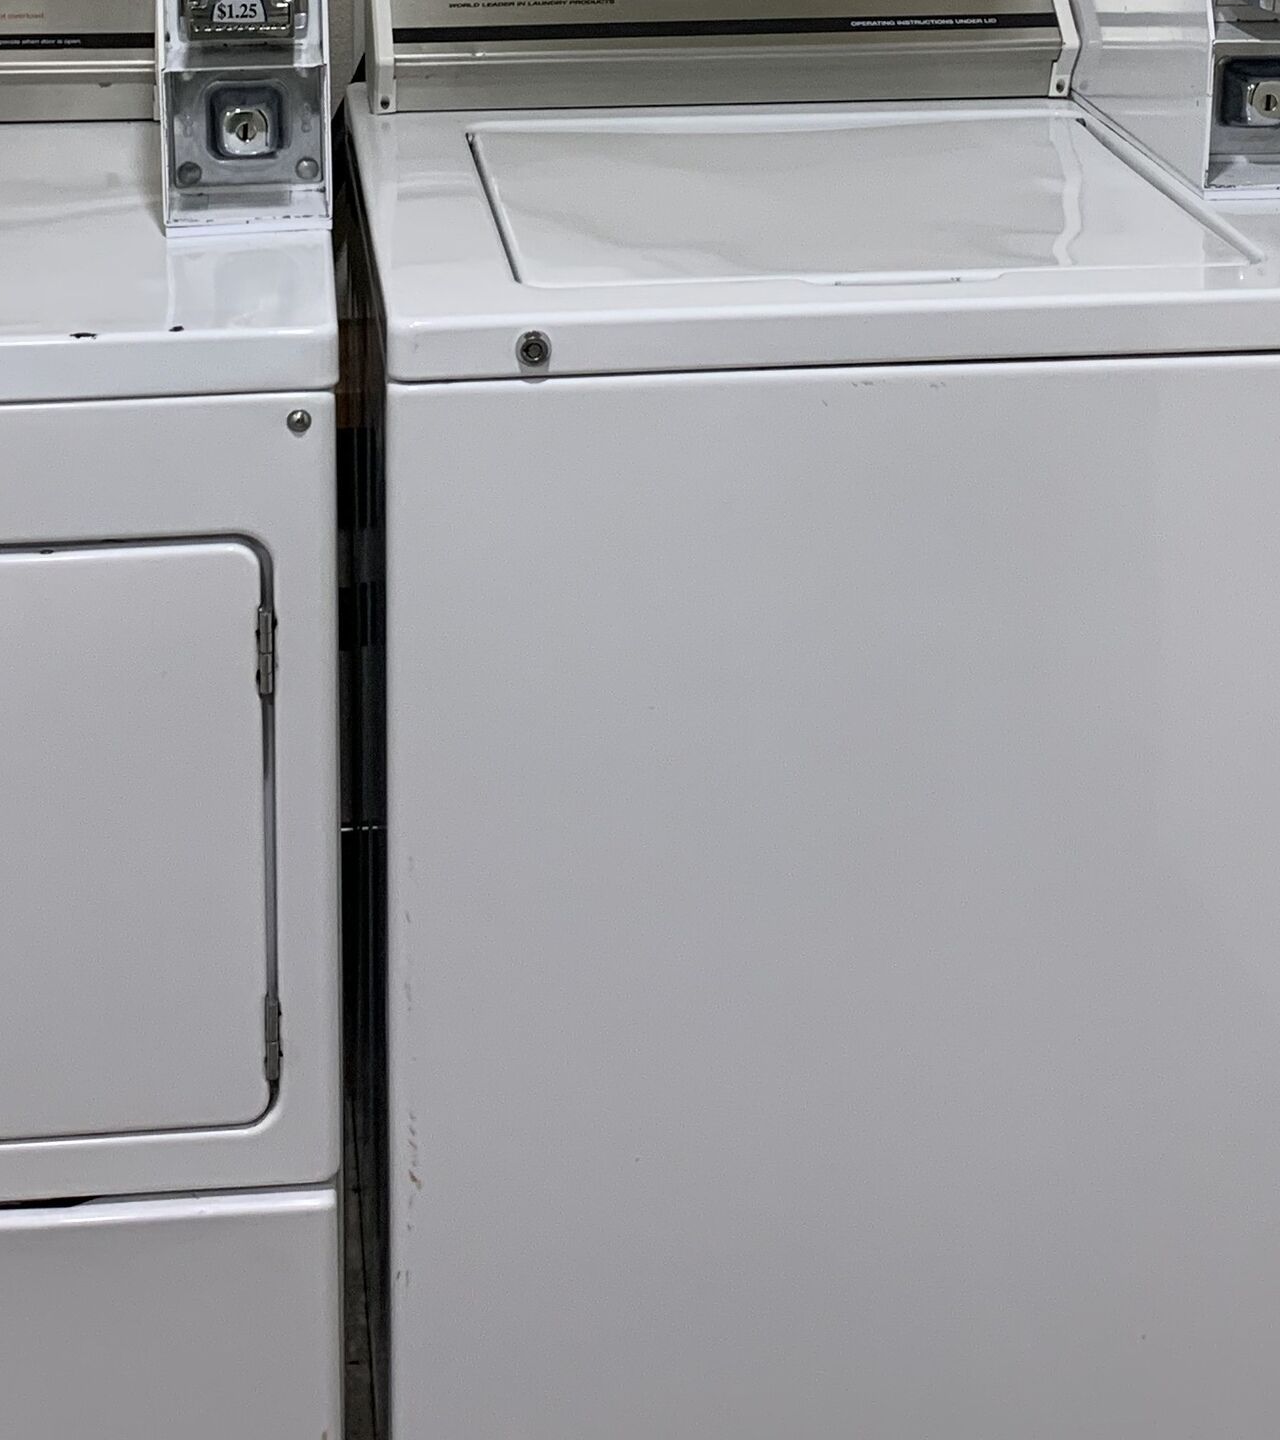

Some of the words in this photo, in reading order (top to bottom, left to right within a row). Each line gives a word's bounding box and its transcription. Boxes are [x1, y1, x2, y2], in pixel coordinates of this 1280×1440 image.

[216, 1, 258, 21] $1.25
[850, 19, 896, 27] OPERATING
[896, 18, 954, 26] INSTRUCTIONS
[954, 17, 983, 25] UNDER
